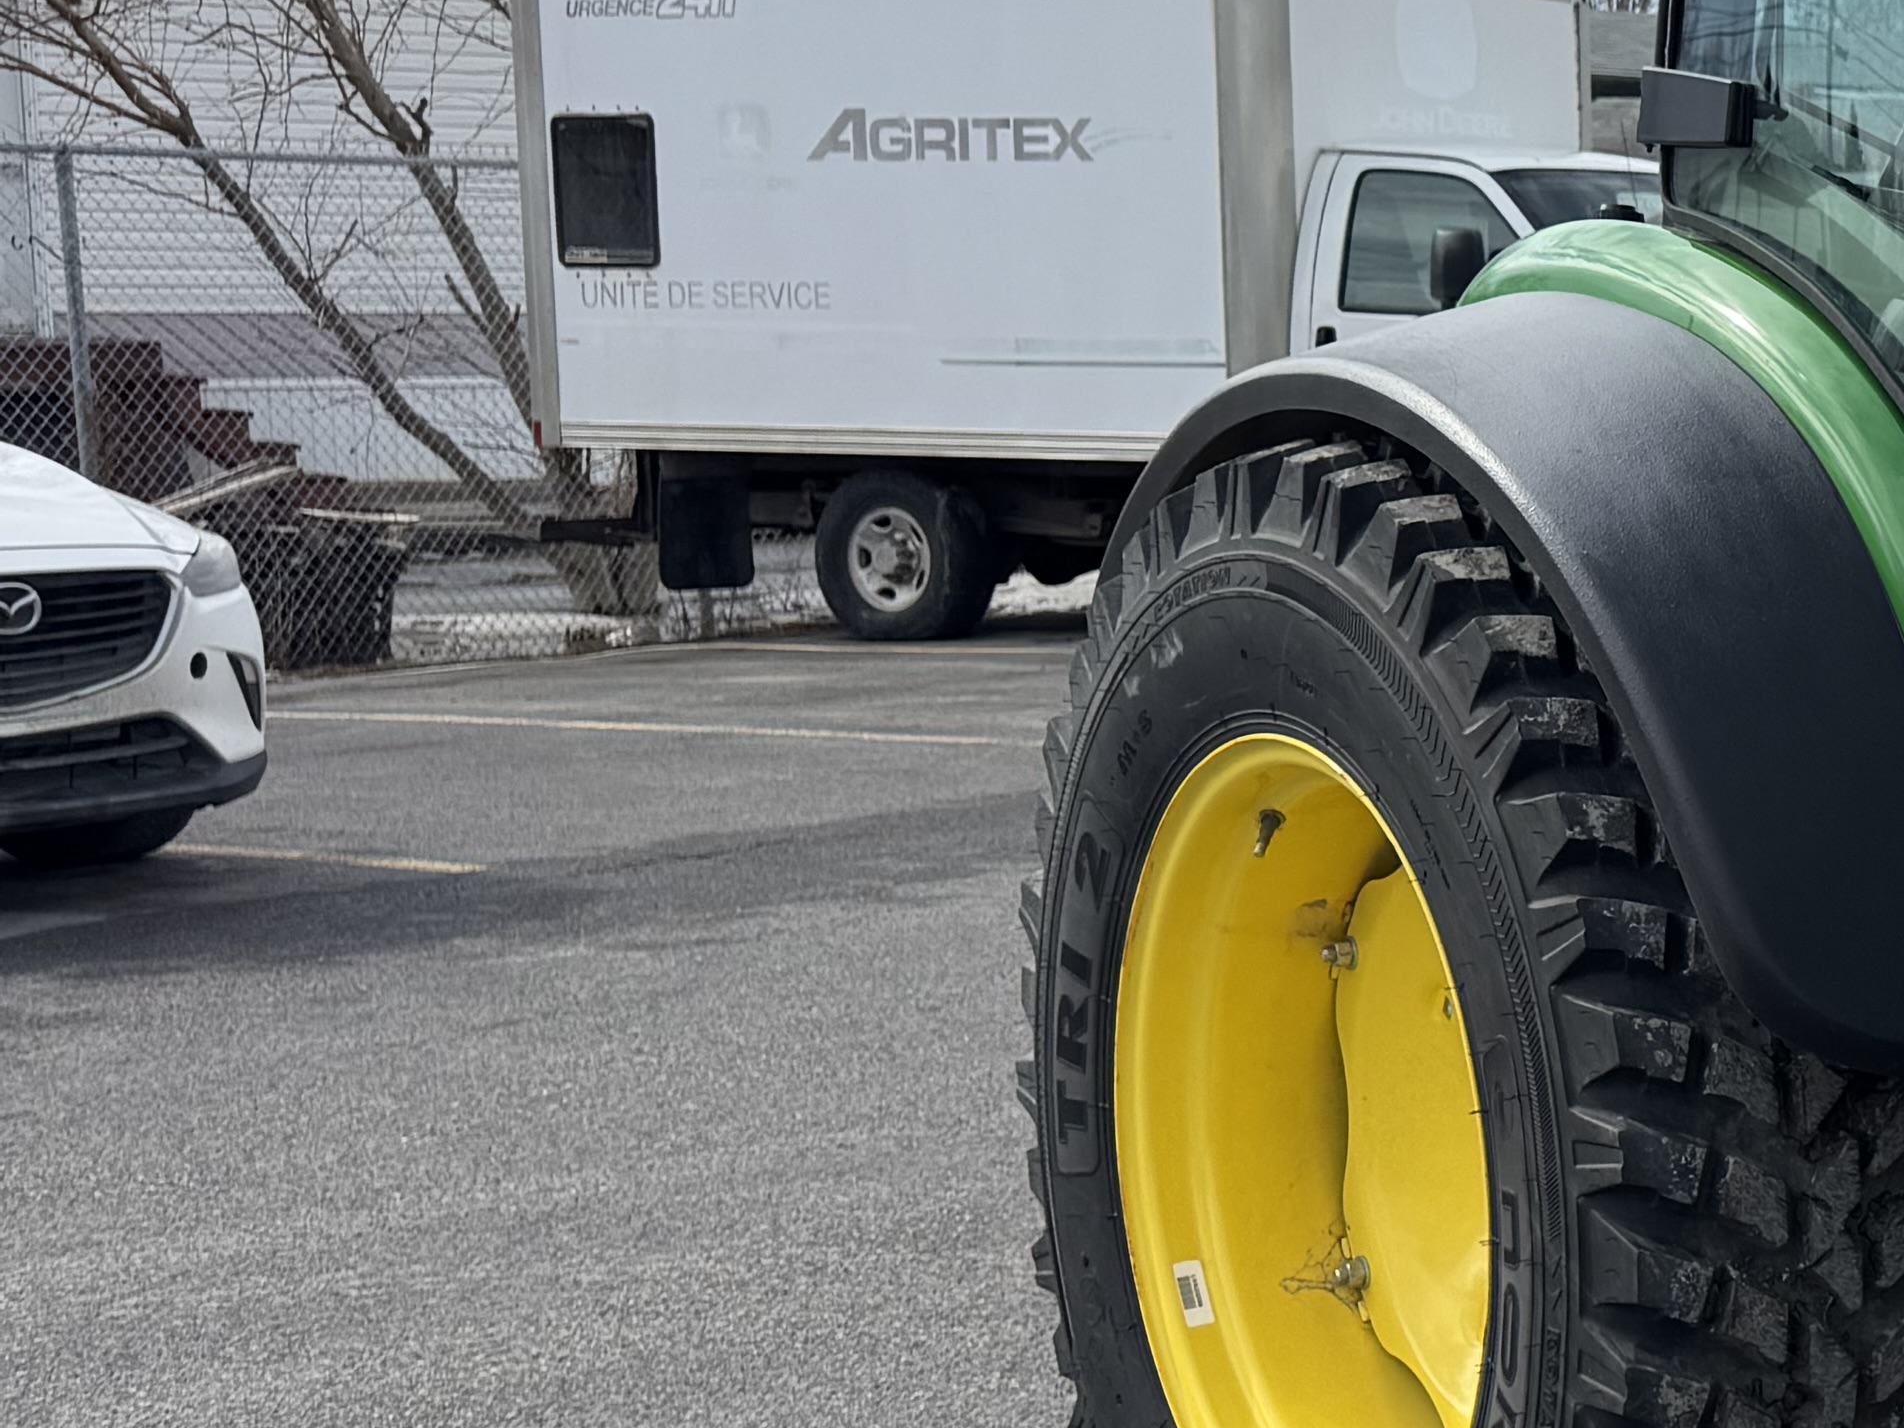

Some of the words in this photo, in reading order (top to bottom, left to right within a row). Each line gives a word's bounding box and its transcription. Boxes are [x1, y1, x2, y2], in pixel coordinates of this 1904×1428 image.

[806, 108, 1094, 162] AGRITEX
[668, 280, 704, 310] DE
[712, 280, 831, 310] SERVICE
[1056, 939, 1093, 1146] TRI
[1075, 831, 1112, 914] 2
